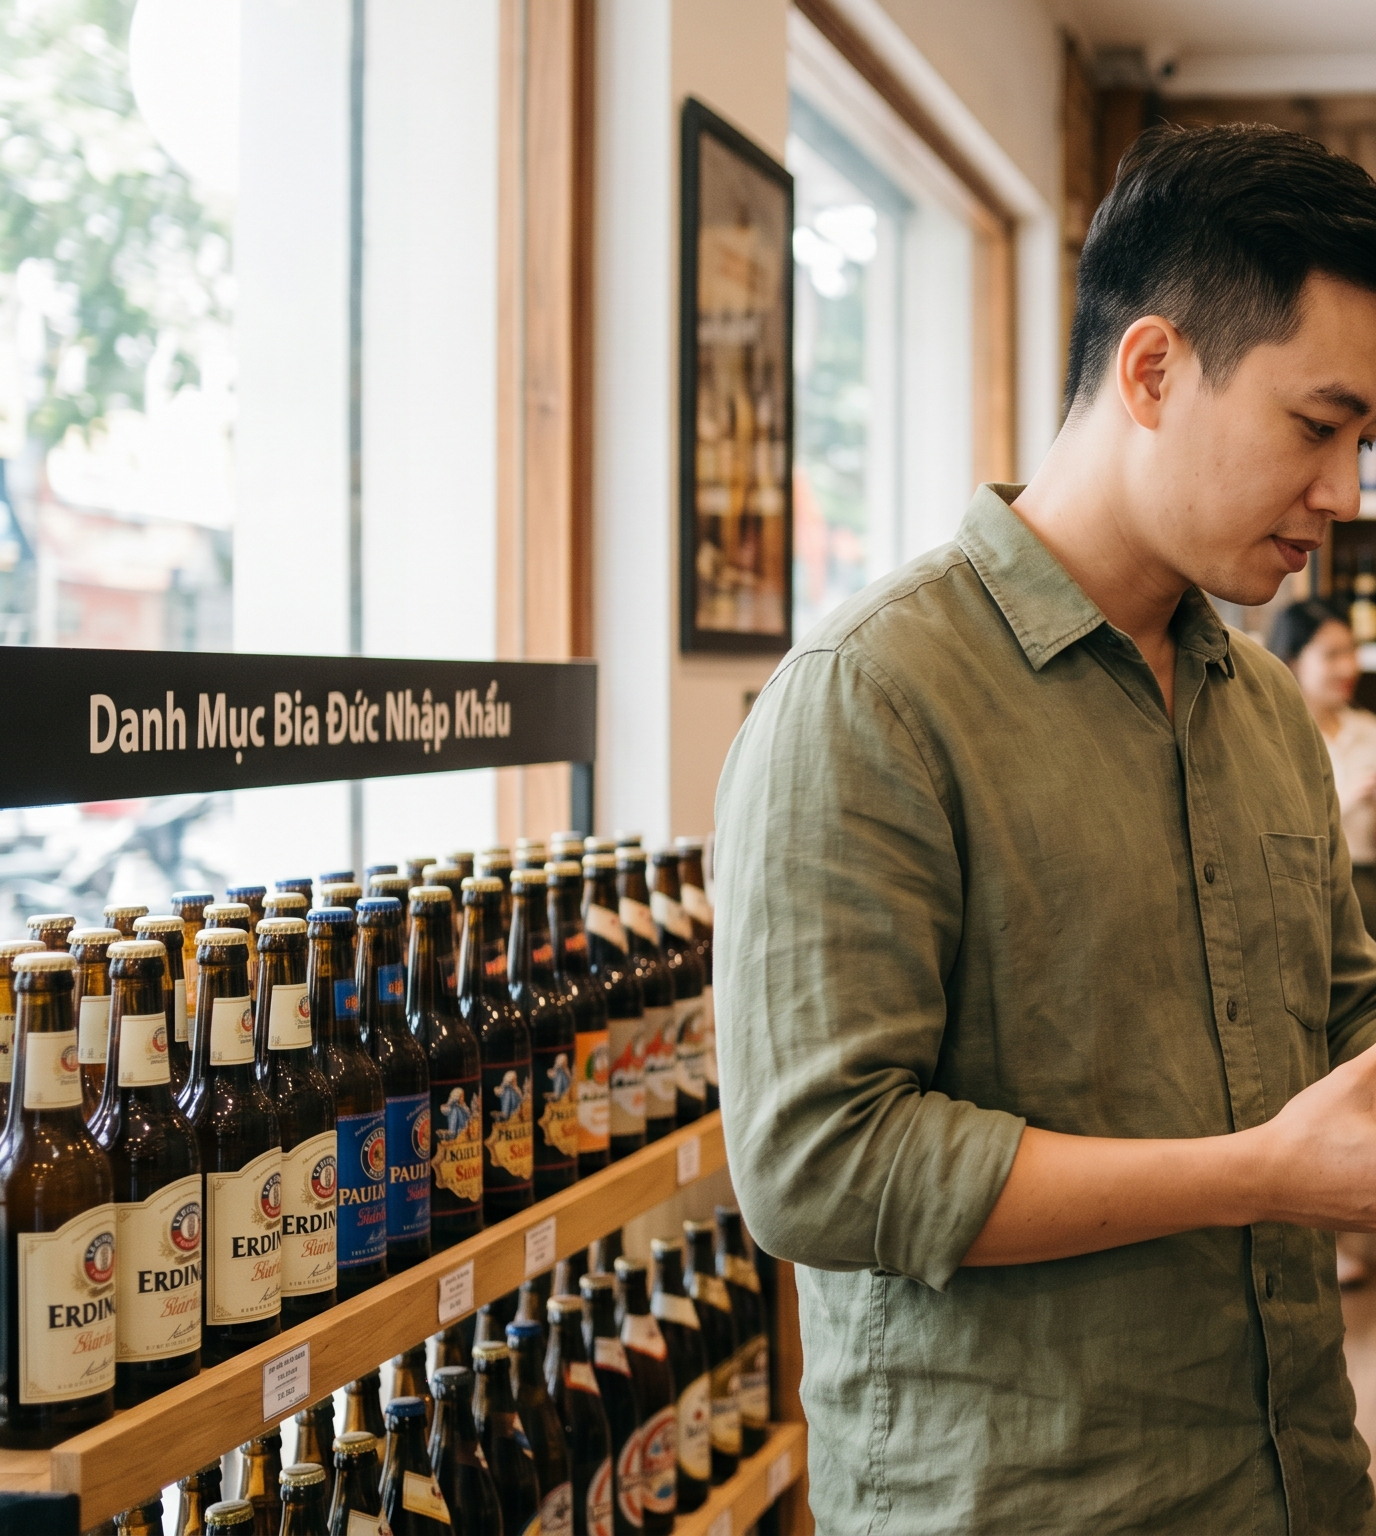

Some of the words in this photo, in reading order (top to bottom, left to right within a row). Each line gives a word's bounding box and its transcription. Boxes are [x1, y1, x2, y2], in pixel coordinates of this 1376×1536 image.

[90, 691, 187, 754] Danh
[197, 692, 266, 765] Mục
[274, 690, 320, 746] Bia
[326, 689, 380, 745] Đức
[386, 688, 450, 754] Nhập
